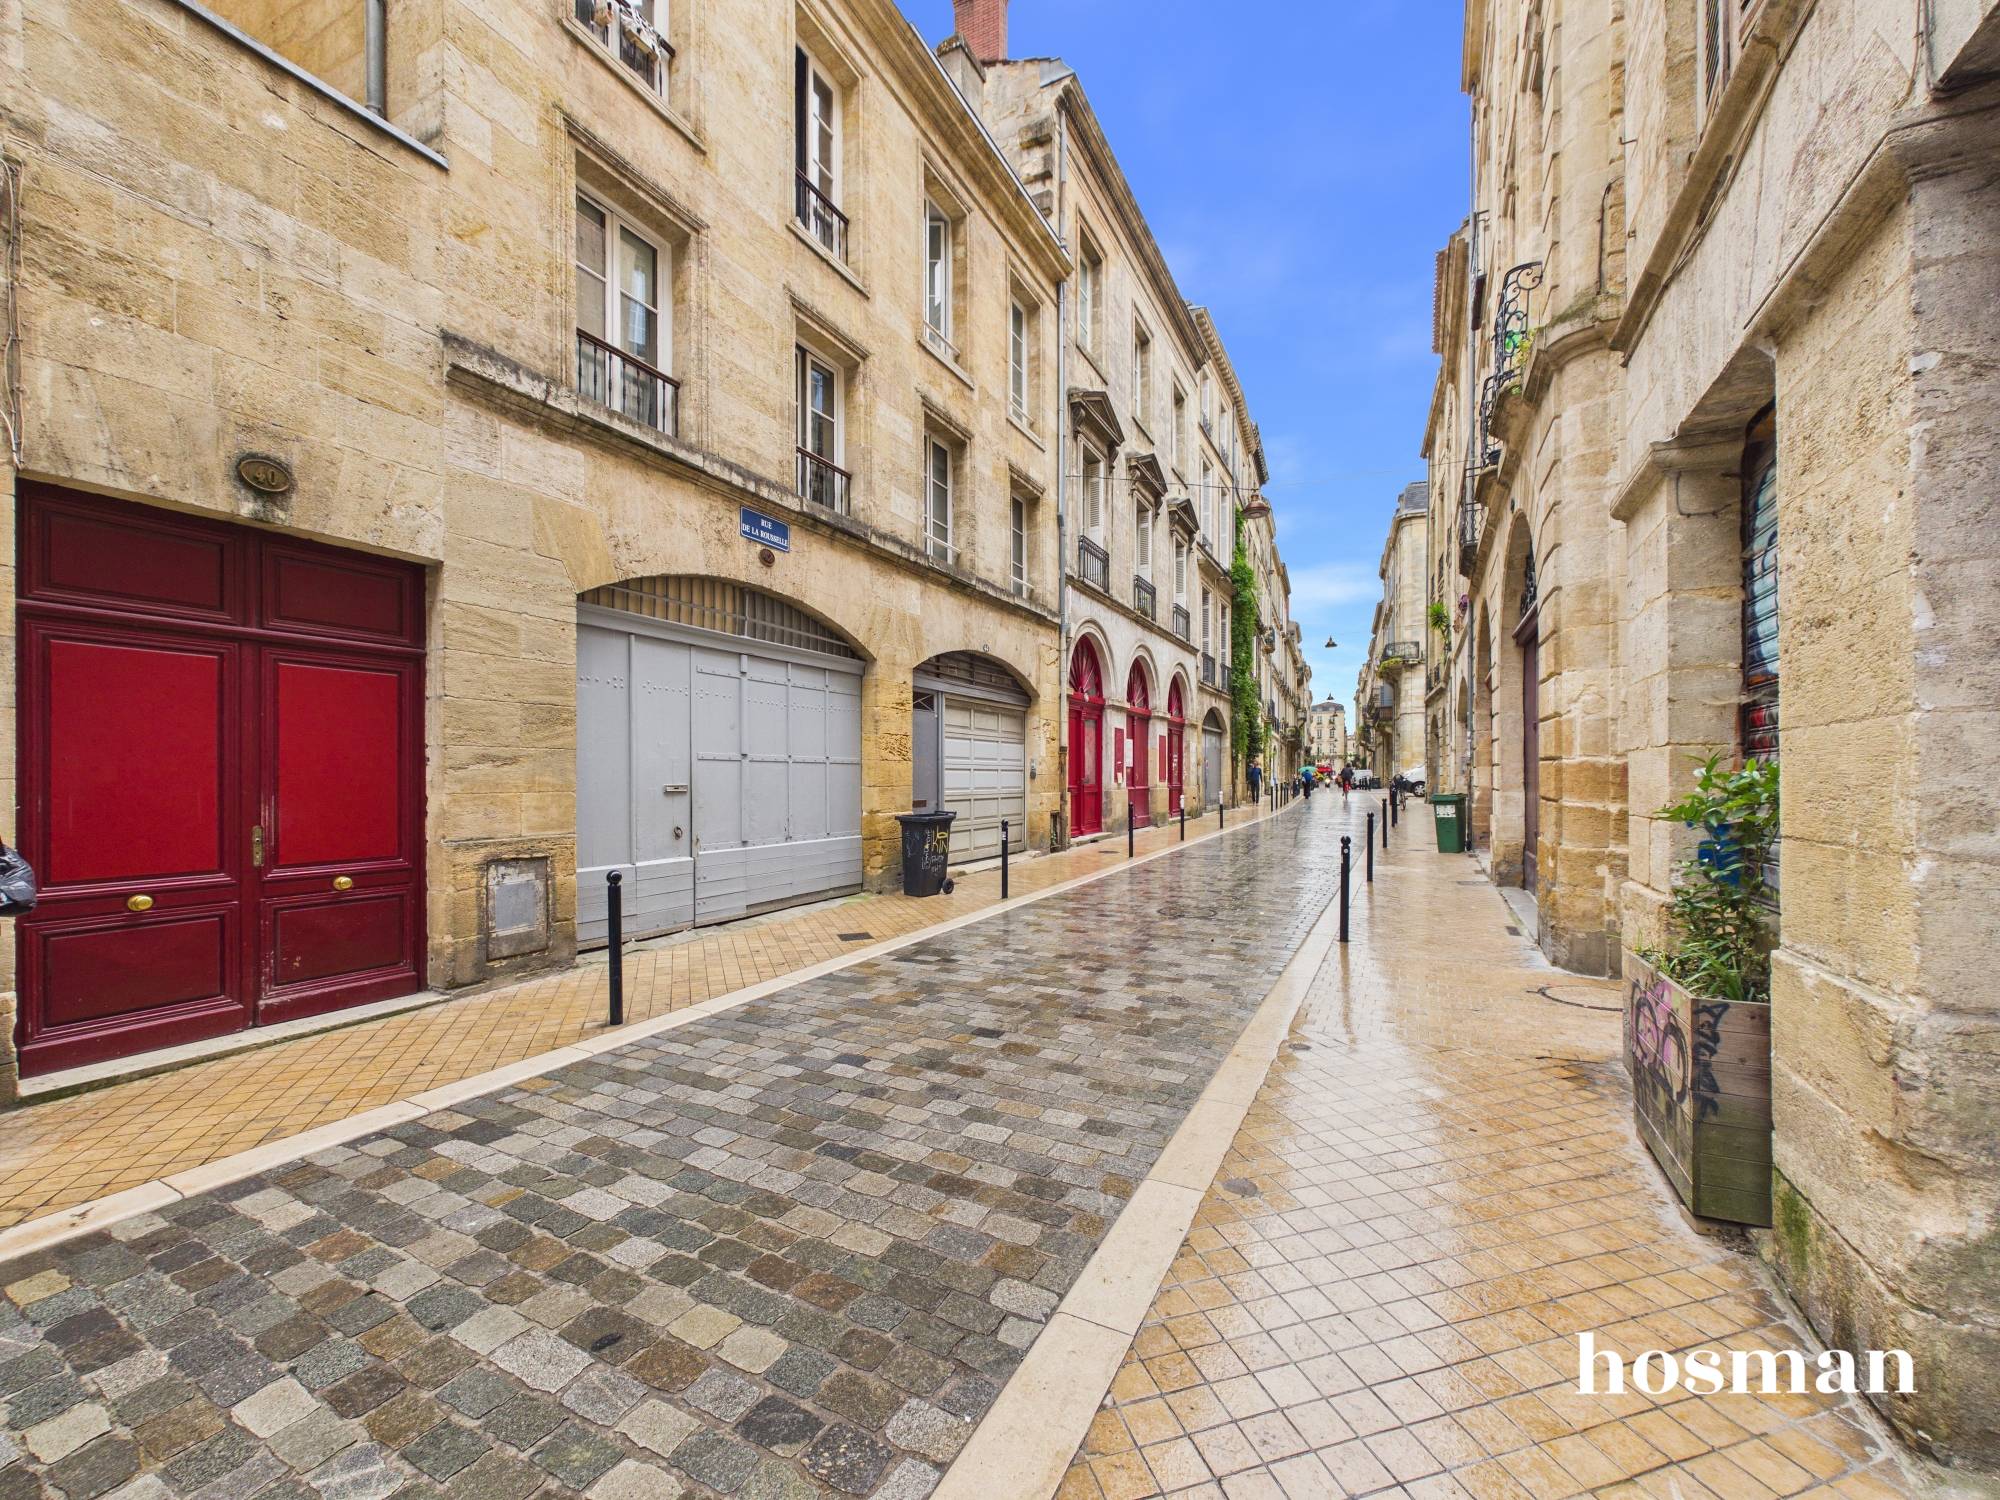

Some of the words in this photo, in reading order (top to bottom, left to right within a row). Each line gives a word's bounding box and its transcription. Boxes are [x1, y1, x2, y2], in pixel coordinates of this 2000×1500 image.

[742, 523, 750, 532] DE
[752, 527, 759, 535] LA
[761, 519, 772, 529] RUE
